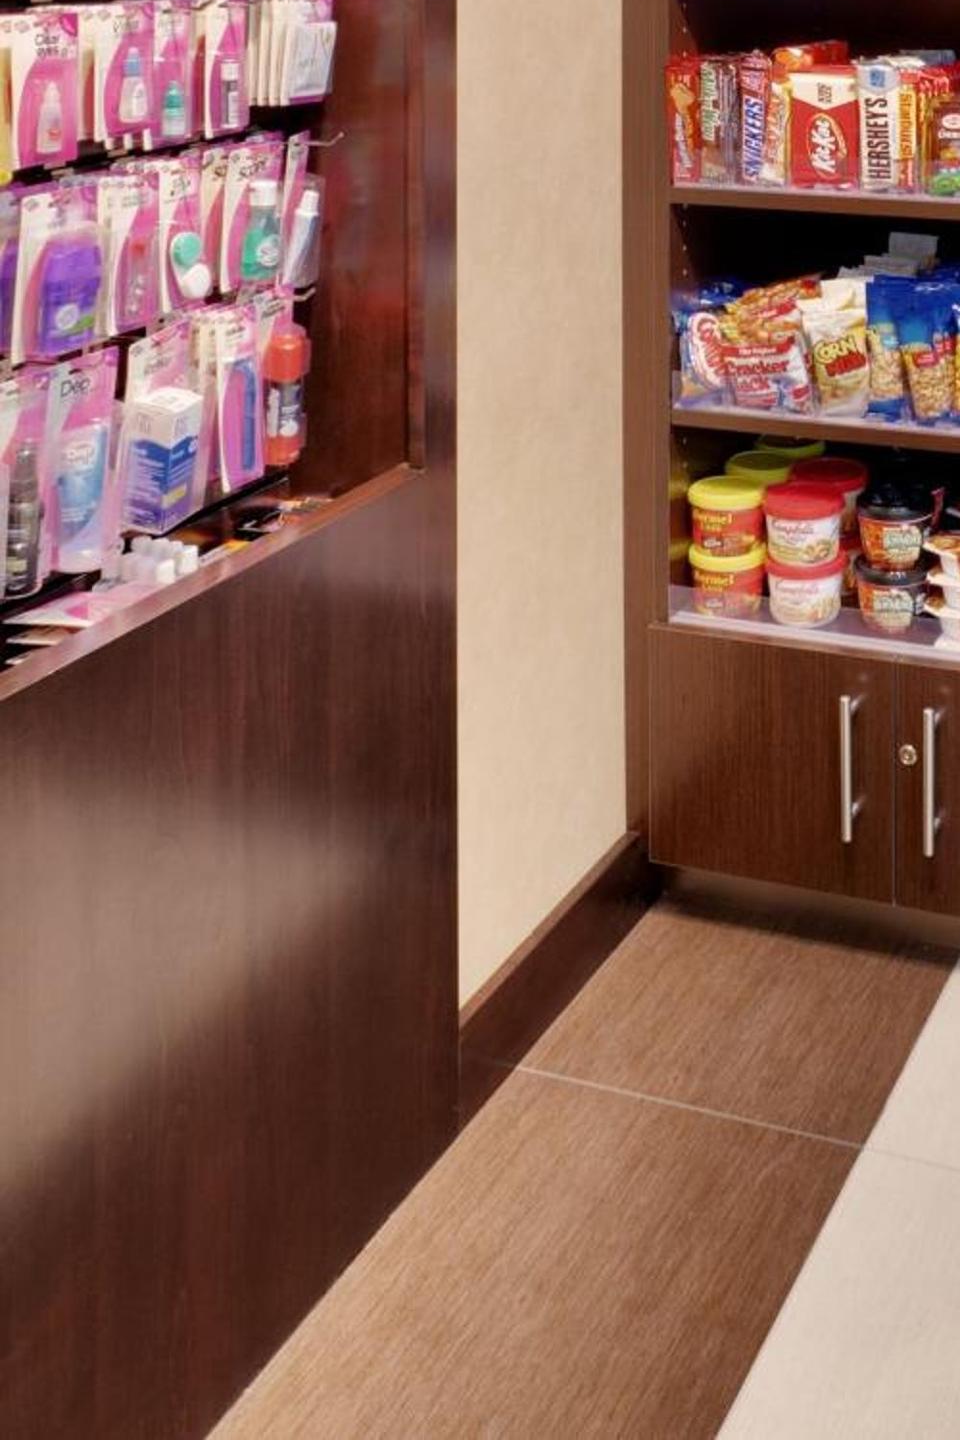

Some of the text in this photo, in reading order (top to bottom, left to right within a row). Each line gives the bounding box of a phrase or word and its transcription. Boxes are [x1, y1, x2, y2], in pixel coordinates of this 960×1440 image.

[742, 98, 766, 180] SNICKERS
[864, 97, 892, 180] HERSHEY'S
[813, 333, 860, 366] CORN
